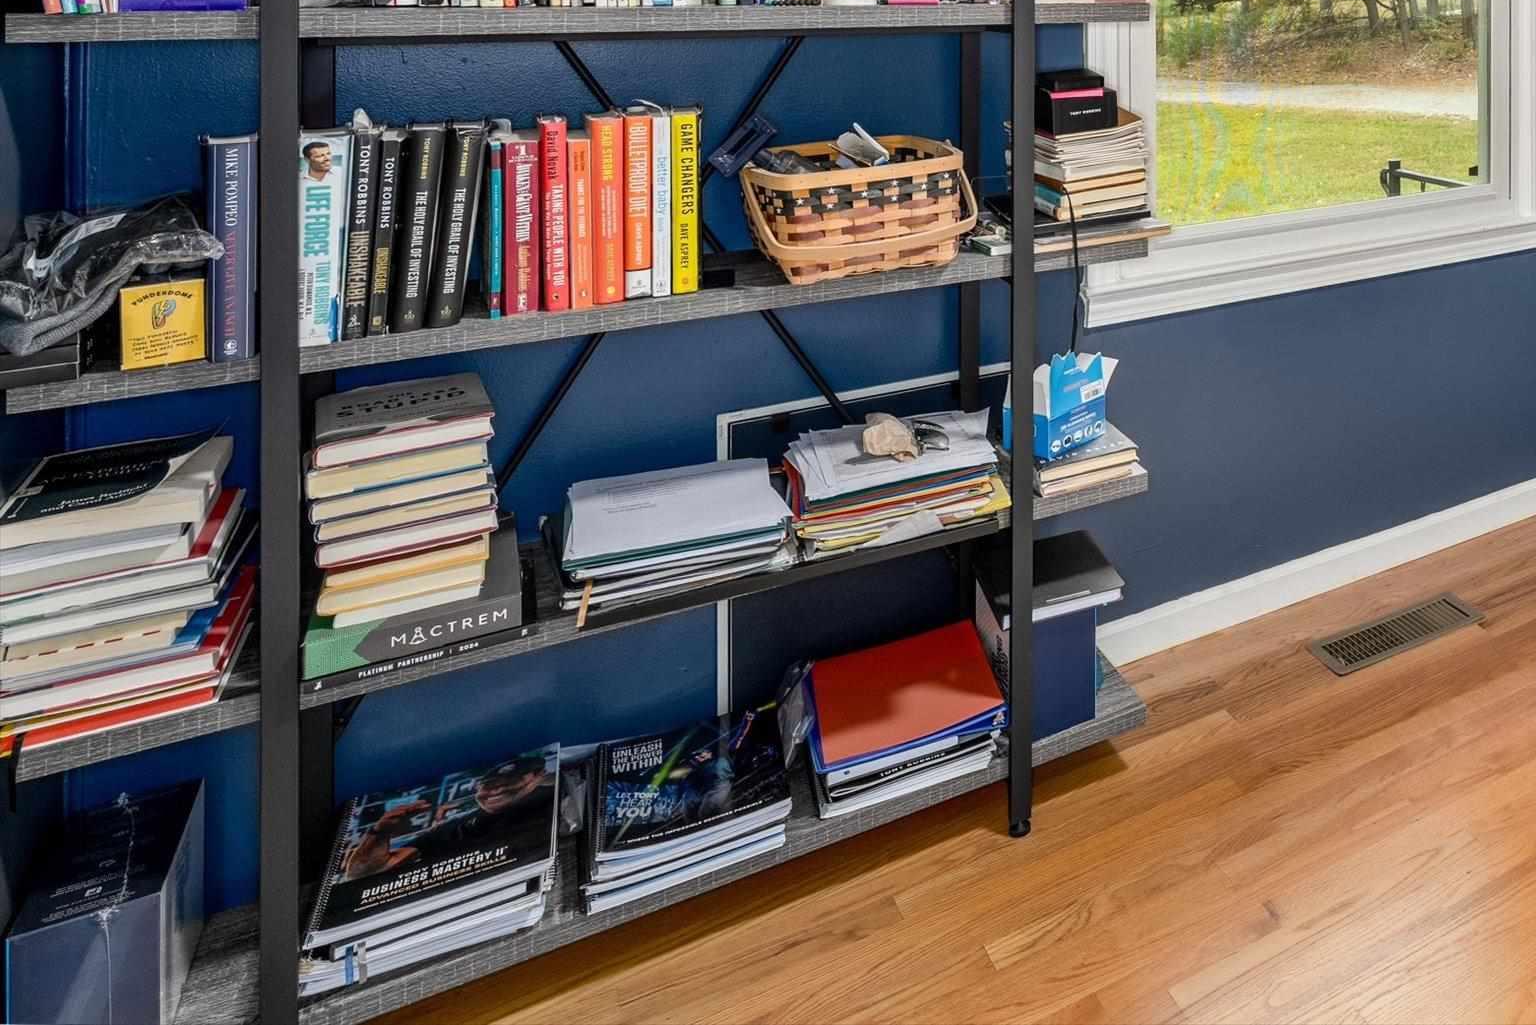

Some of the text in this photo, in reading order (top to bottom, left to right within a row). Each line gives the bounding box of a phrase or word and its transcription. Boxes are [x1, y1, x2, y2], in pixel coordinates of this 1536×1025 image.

[628, 126, 647, 218] BULLETPROOF DIET
[225, 148, 238, 226] MIKE POMPEO
[454, 188, 466, 202] THE
[656, 156, 669, 215] better baby
[680, 123, 694, 268] GAME CHANGERS DAVE ASPREY
[416, 192, 428, 206] THE
[547, 131, 565, 286] David Novak TAKING PEOPLE WITH YOU
[414, 206, 426, 225] HOLY
[452, 203, 464, 222] HOLY
[346, 145, 371, 307] TONY ROBBINS UNSHAKEABLE
[373, 157, 395, 294] TONY ROBBINS UNSHAKEABLE
[412, 226, 424, 247] GRAIL
[450, 223, 463, 244] GRAIL
[304, 185, 331, 325] LIFE FORCE TONY ROBBINS
[411, 248, 422, 258] OF
[449, 244, 460, 254] OF
[406, 259, 421, 298] INVESTING
[443, 255, 459, 294] INVESTING
[336, 390, 465, 416] STUPID
[358, 642, 479, 678] PLATINUM PARTNERSHIP 2024
[613, 741, 662, 758] UNLEASH
[613, 749, 662, 765] THE POWER
[613, 756, 662, 774] WITHIN
[616, 807, 651, 818] YOU
[620, 799, 653, 807] HEAR
[360, 856, 507, 905] ADVANCED BUSINESS SKILLS
[361, 850, 494, 899] BUSINESS MASTERY
[398, 866, 428, 879] TONY
